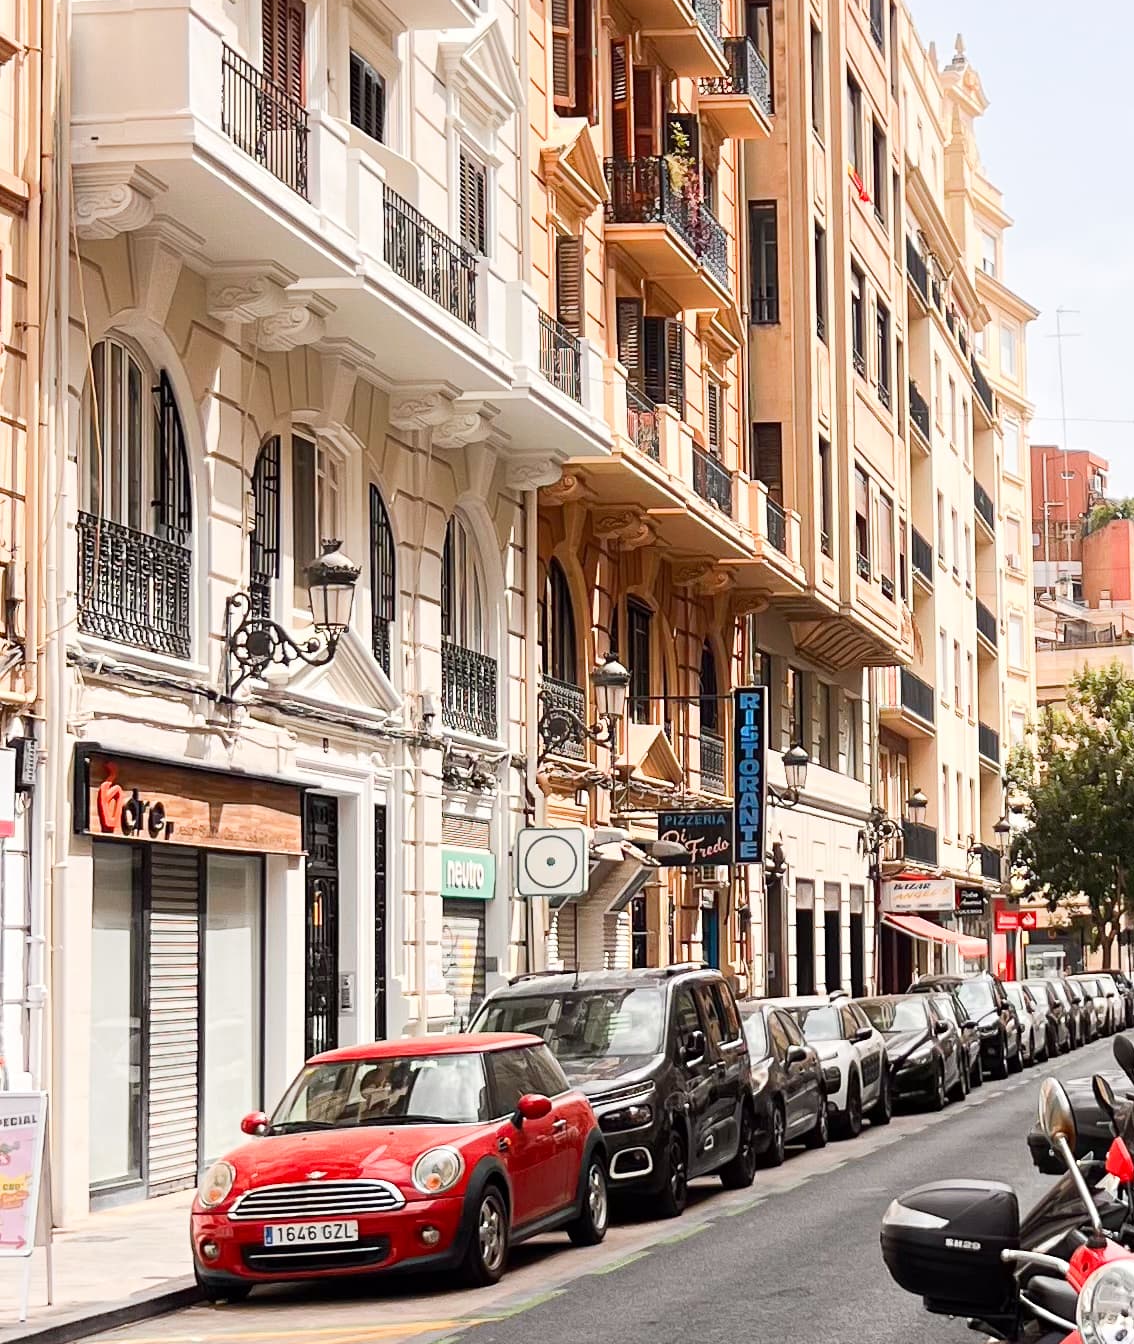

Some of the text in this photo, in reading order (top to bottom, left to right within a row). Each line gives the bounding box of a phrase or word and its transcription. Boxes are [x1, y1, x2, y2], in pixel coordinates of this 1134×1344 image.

[739, 692, 761, 858] RISTORANTE
[664, 814, 726, 826] PIZZERIA
[685, 836, 730, 863] Fredo
[446, 859, 485, 889] neutro
[893, 882, 931, 891] BAZAR
[277, 1223, 354, 1242] 1646 GZL
